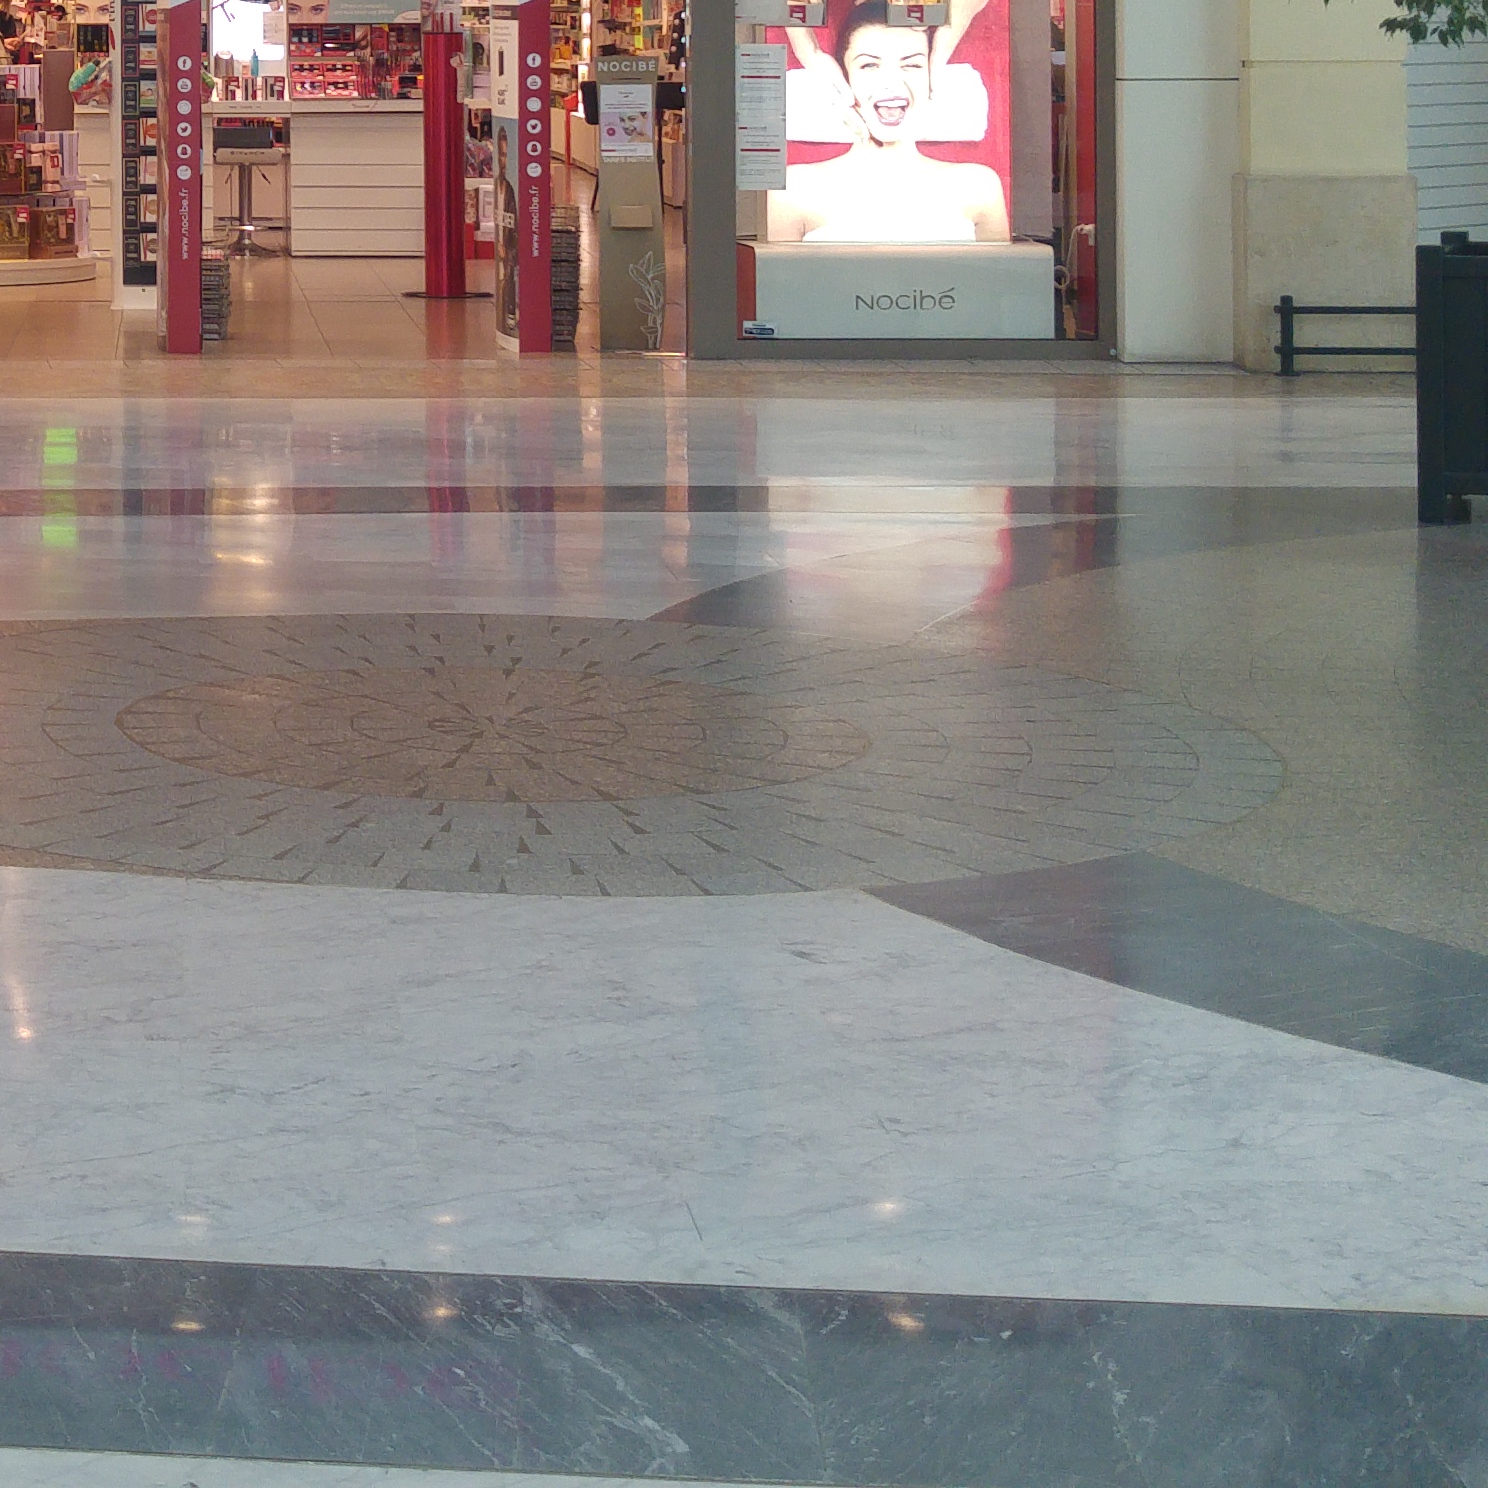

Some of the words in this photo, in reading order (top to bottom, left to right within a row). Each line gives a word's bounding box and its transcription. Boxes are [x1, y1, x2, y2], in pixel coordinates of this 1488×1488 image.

[597, 60, 656, 72] NOCIBÉ
[179, 188, 189, 260] www.nocibe.fr
[529, 185, 540, 258] www.nocibe.fr
